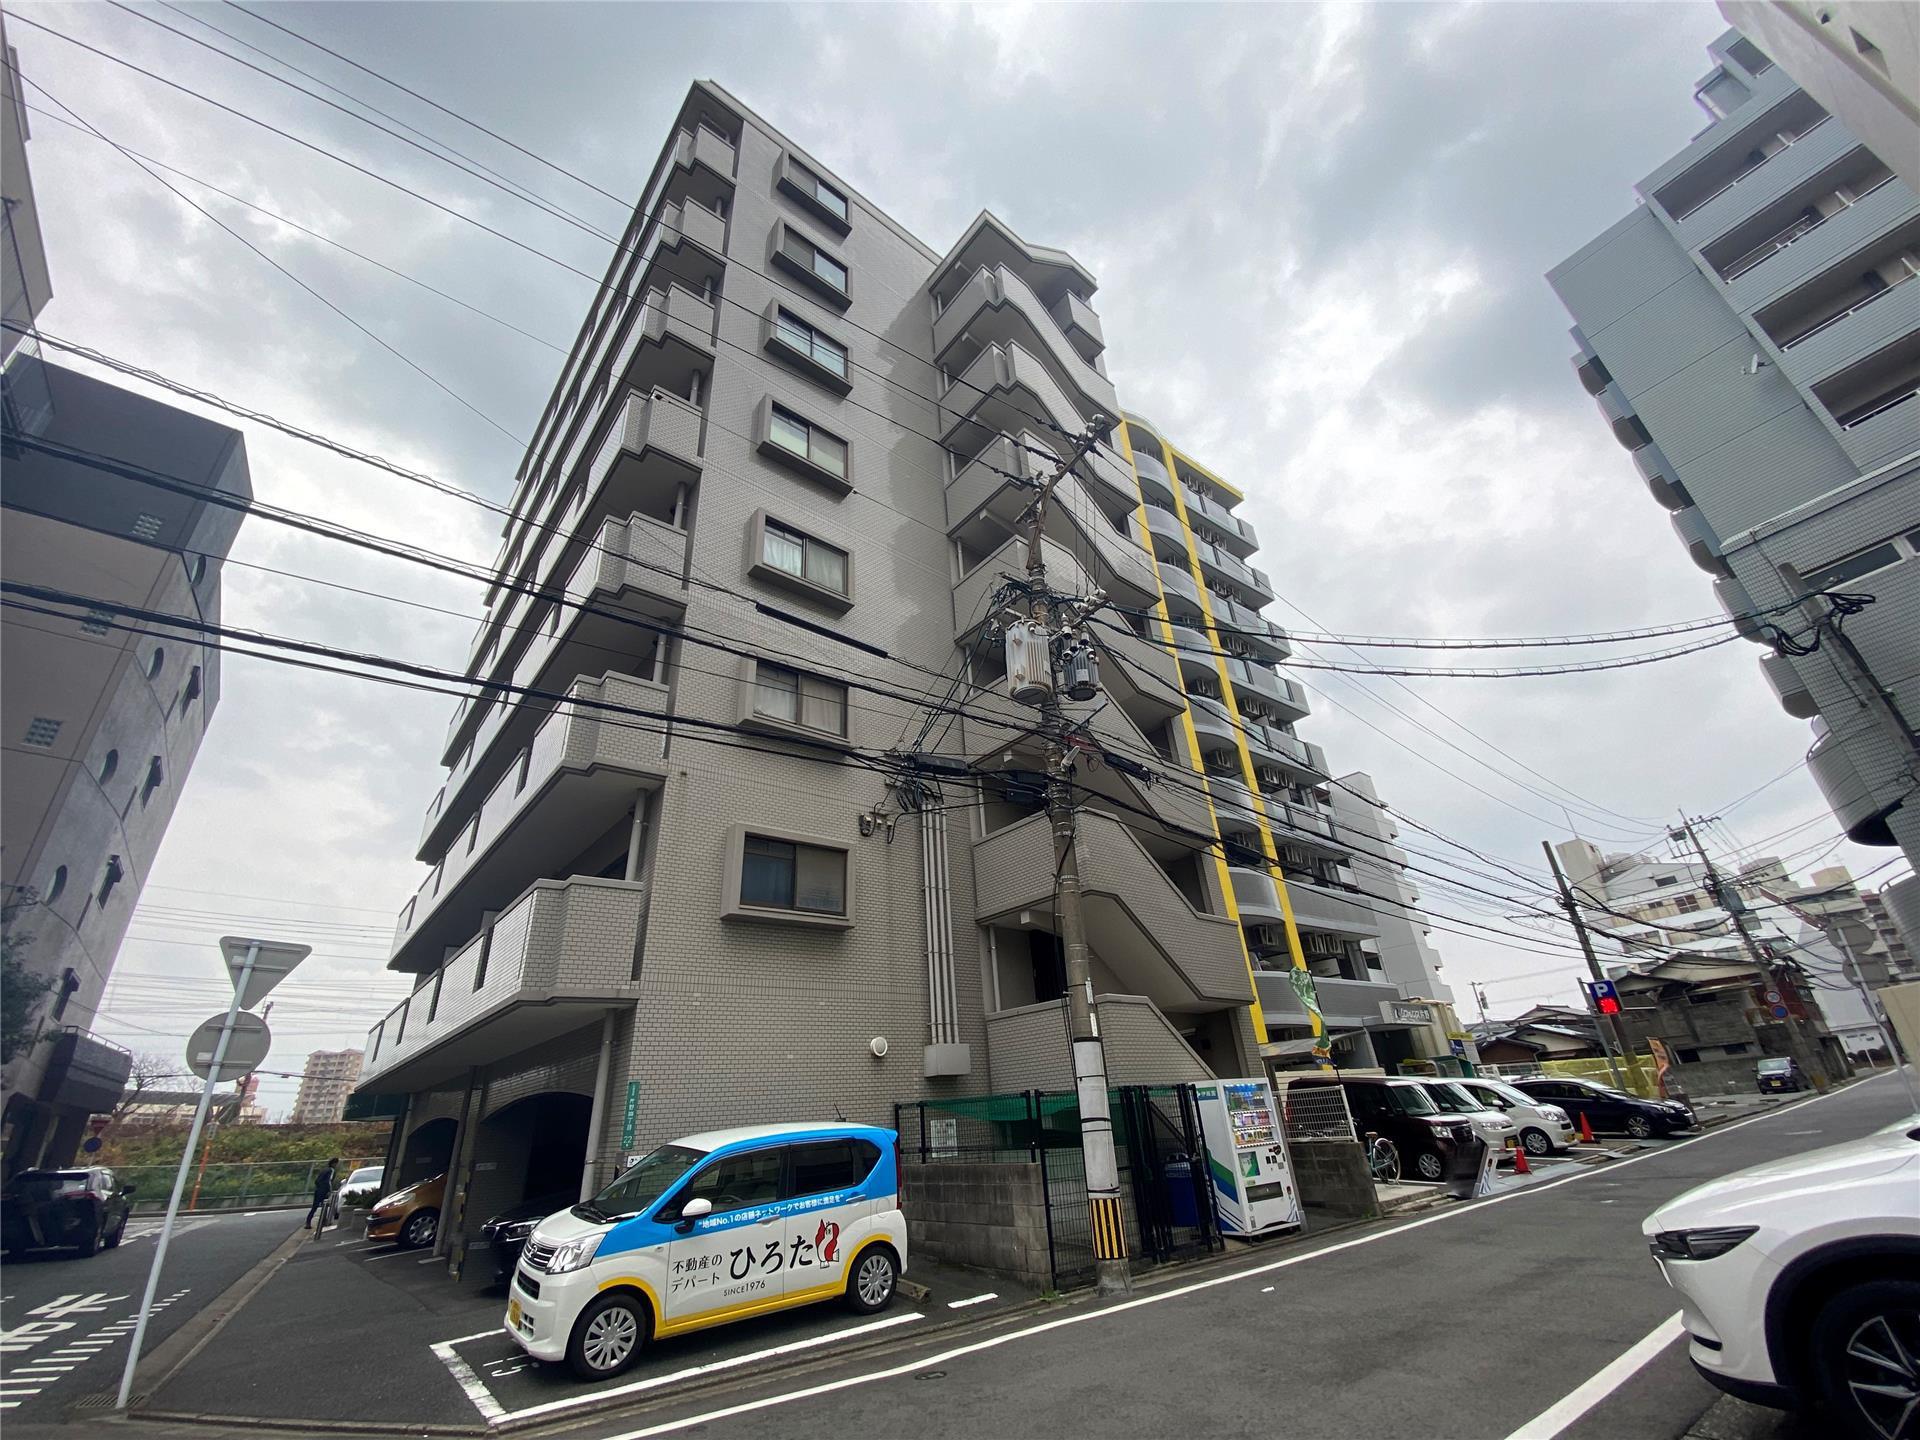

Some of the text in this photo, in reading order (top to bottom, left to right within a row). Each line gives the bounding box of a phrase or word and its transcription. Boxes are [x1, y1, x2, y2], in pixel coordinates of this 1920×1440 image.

[1594, 983, 1608, 997] P
[672, 1253, 723, 1275] 不動産の
[729, 1235, 814, 1280] ひろた
[671, 1272, 720, 1293] デパート
